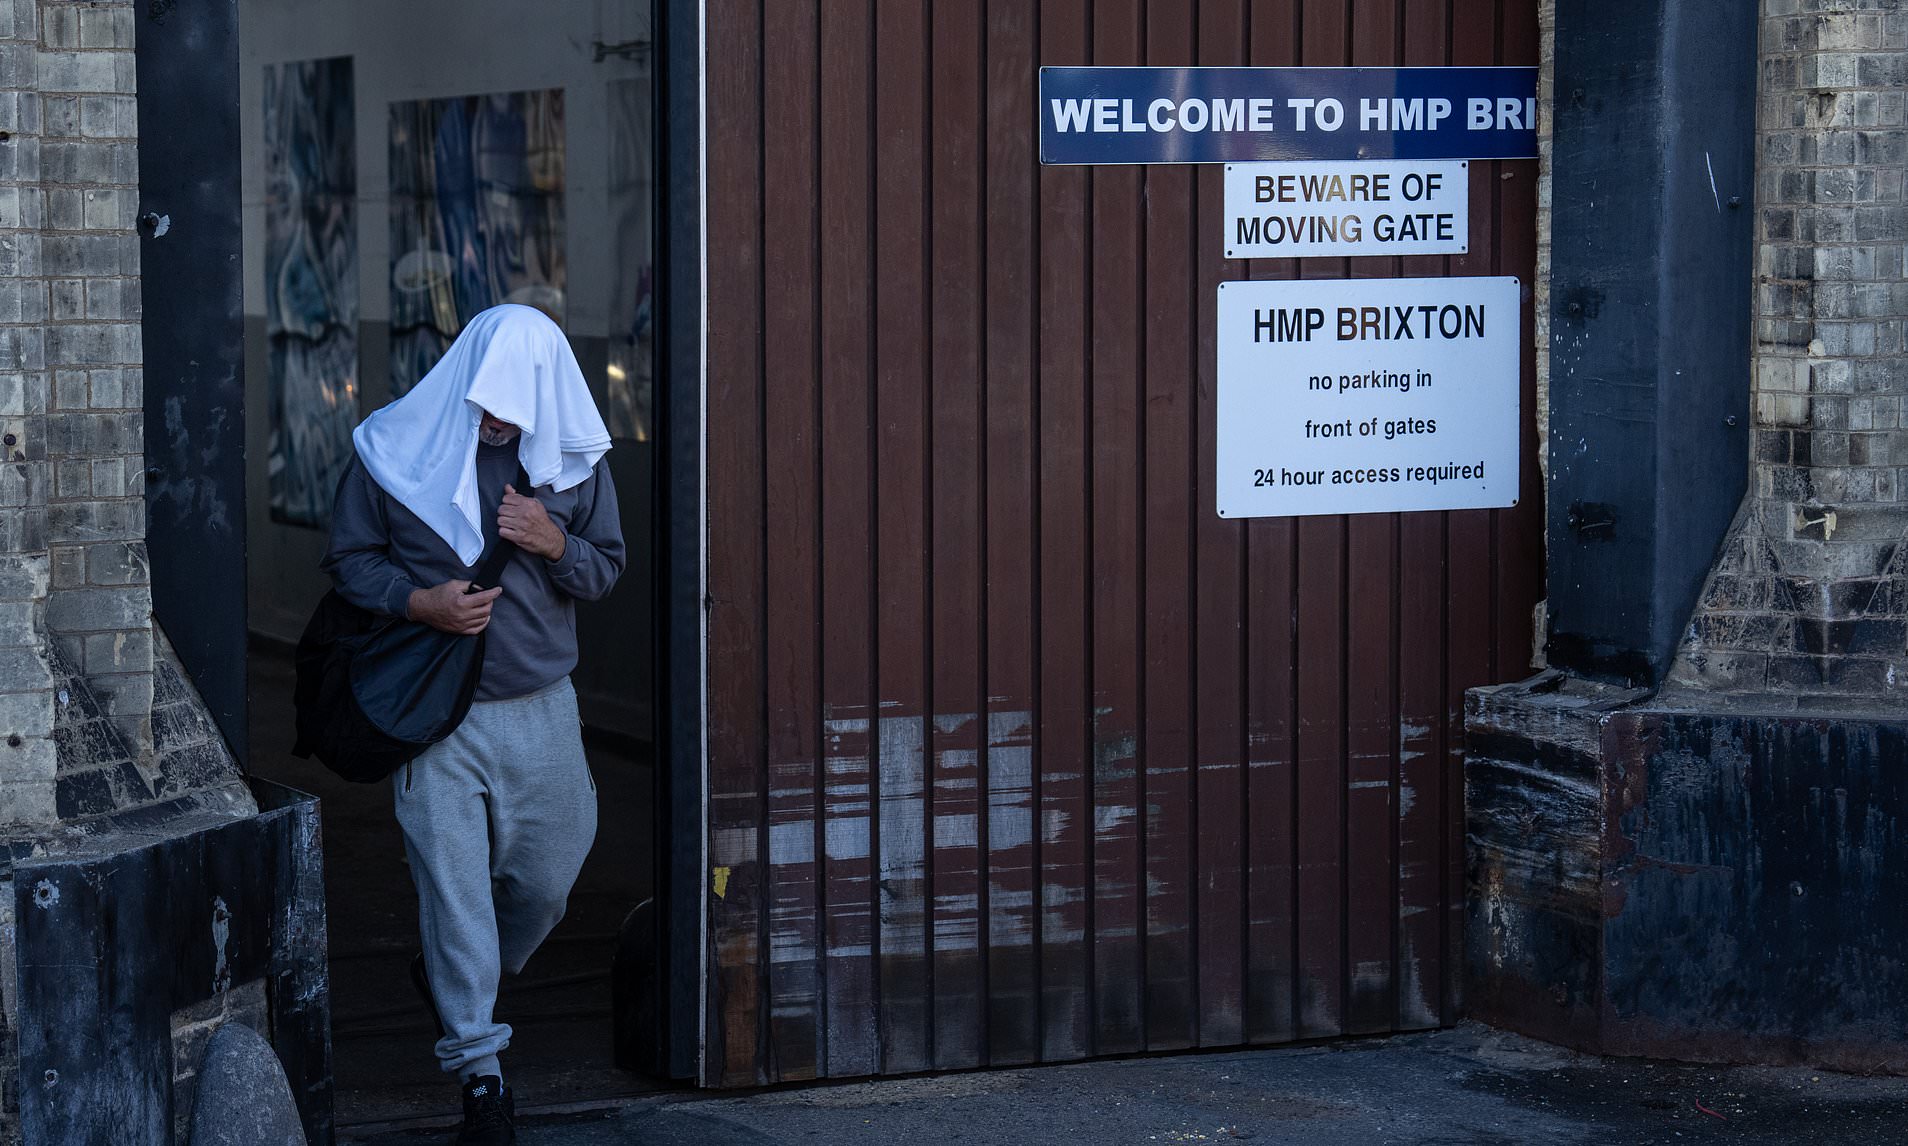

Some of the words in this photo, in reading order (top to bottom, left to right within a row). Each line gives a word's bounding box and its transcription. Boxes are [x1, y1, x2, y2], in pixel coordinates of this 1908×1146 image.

[1051, 98, 1274, 133] WELCOME
[1287, 98, 1345, 132] TO
[1359, 97, 1452, 131] HMP
[1467, 97, 1536, 130] BRI
[1255, 174, 1391, 203] BEWARE
[1401, 173, 1443, 201] OF
[1236, 215, 1362, 245] MOVING
[1373, 213, 1454, 242] GATE
[1254, 308, 1325, 343] HMP
[1336, 304, 1485, 341] BRIXTON
[1309, 374, 1333, 390] no
[1338, 369, 1411, 394] parking
[1416, 368, 1433, 387] in
[1305, 419, 1352, 438] front
[1358, 418, 1378, 436] of
[1384, 417, 1437, 440] gates
[1254, 468, 1275, 487] 24
[1281, 467, 1325, 486] hour
[1331, 465, 1400, 484] access
[1406, 461, 1485, 484] required
